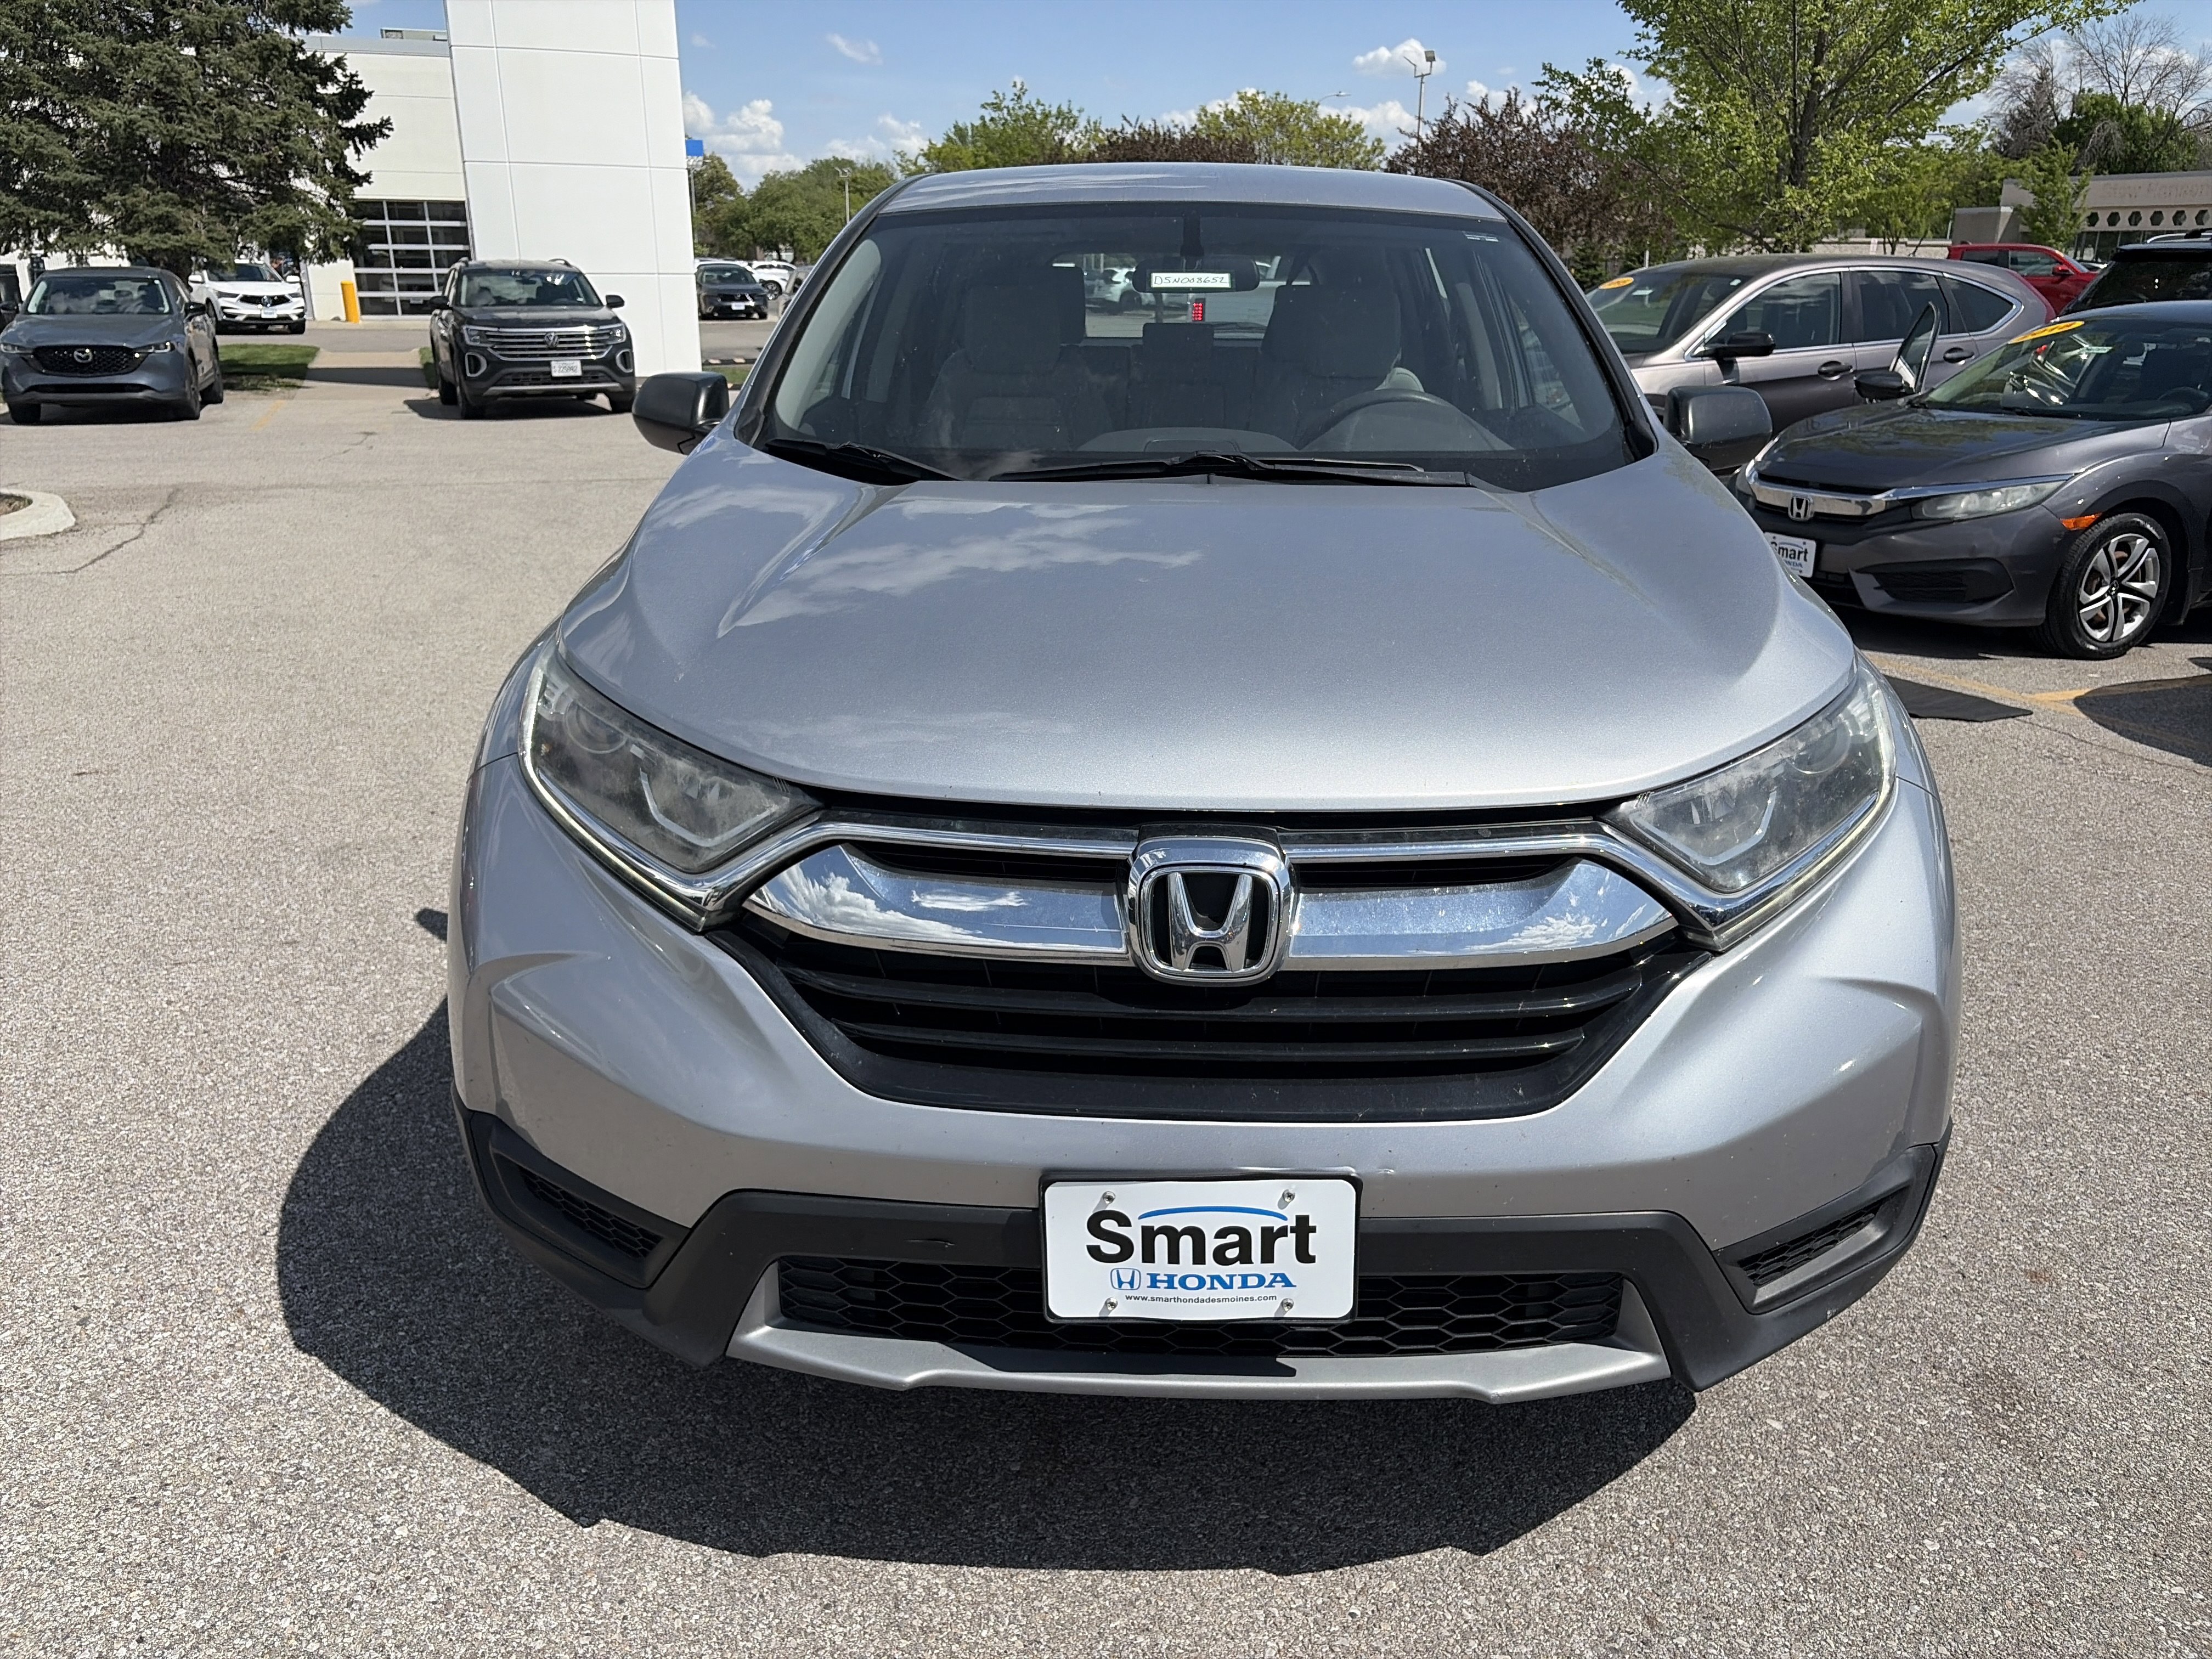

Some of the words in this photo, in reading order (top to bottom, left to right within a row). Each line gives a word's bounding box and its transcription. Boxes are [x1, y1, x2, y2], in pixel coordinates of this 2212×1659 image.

[1086, 1210, 1317, 1266] Smart
[1146, 1272, 1297, 1291] HONDA
[1125, 1294, 1277, 1304] www.smarthondadesmoines.com
